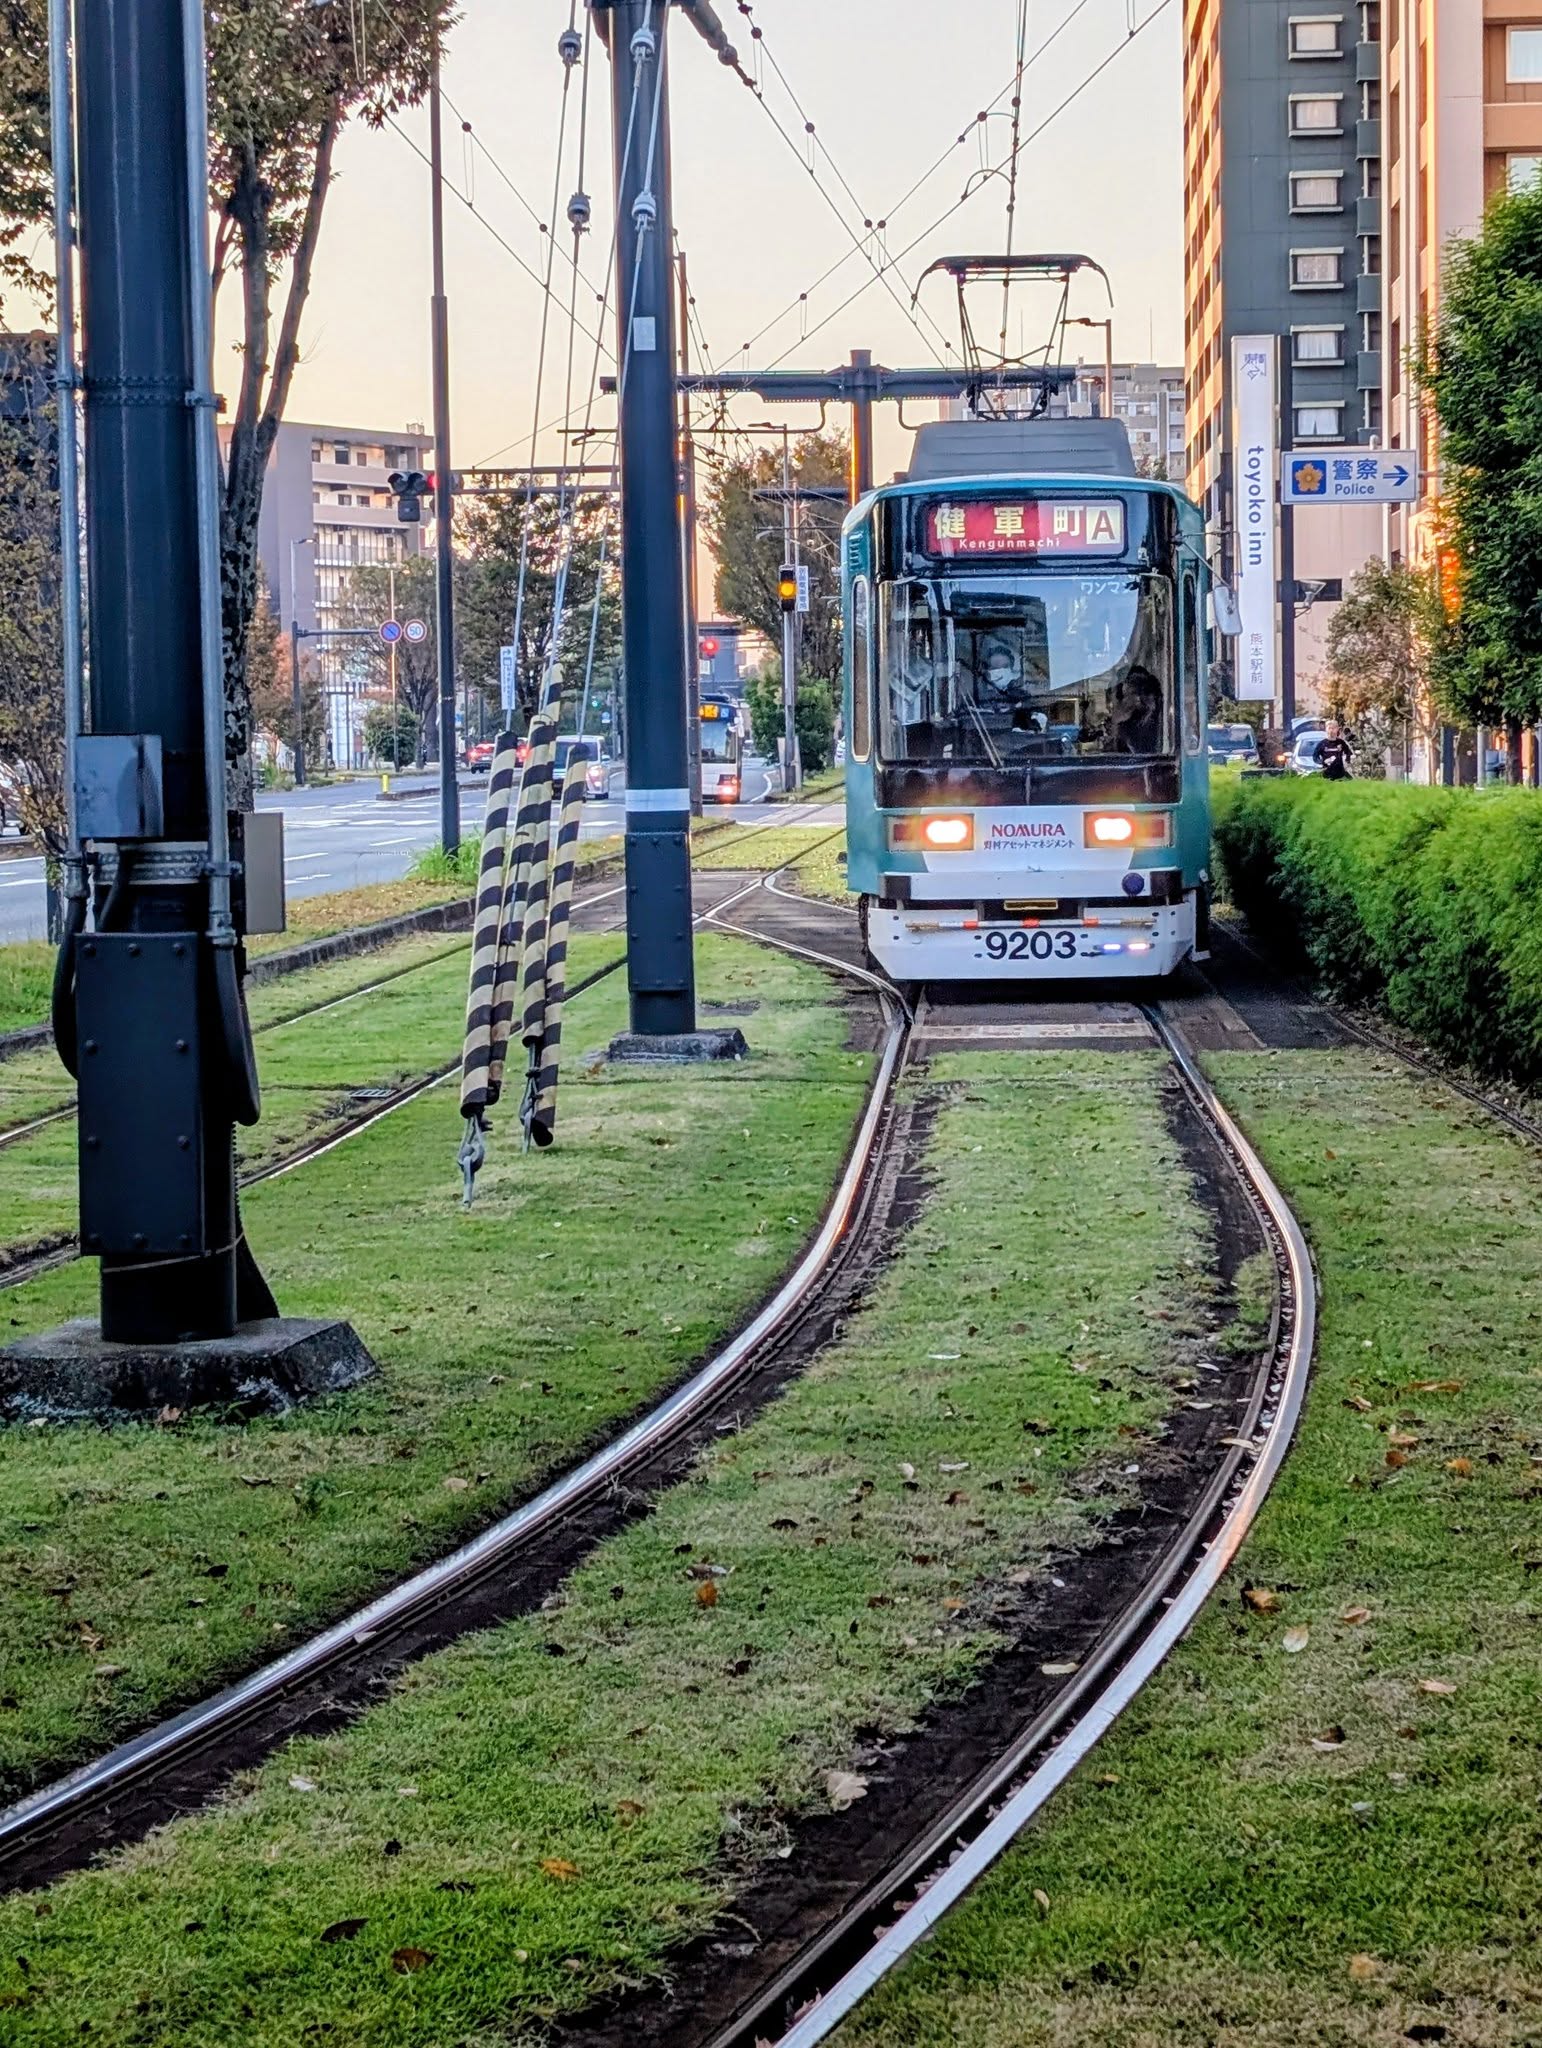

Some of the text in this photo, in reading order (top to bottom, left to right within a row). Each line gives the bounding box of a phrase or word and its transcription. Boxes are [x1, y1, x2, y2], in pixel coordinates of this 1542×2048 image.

[1332, 458, 1378, 480] 警察
[1334, 483, 1375, 496] Police
[1244, 445, 1267, 566] toyoko inn
[934, 505, 1116, 541] 健軍町 A
[958, 538, 1061, 551] Kengunmachi
[1250, 633, 1264, 684] 熊本駅前
[991, 823, 1066, 838] NOMURA
[983, 839, 1076, 851] 野村アセットマネジメント
[985, 930, 1077, 960] 9203
